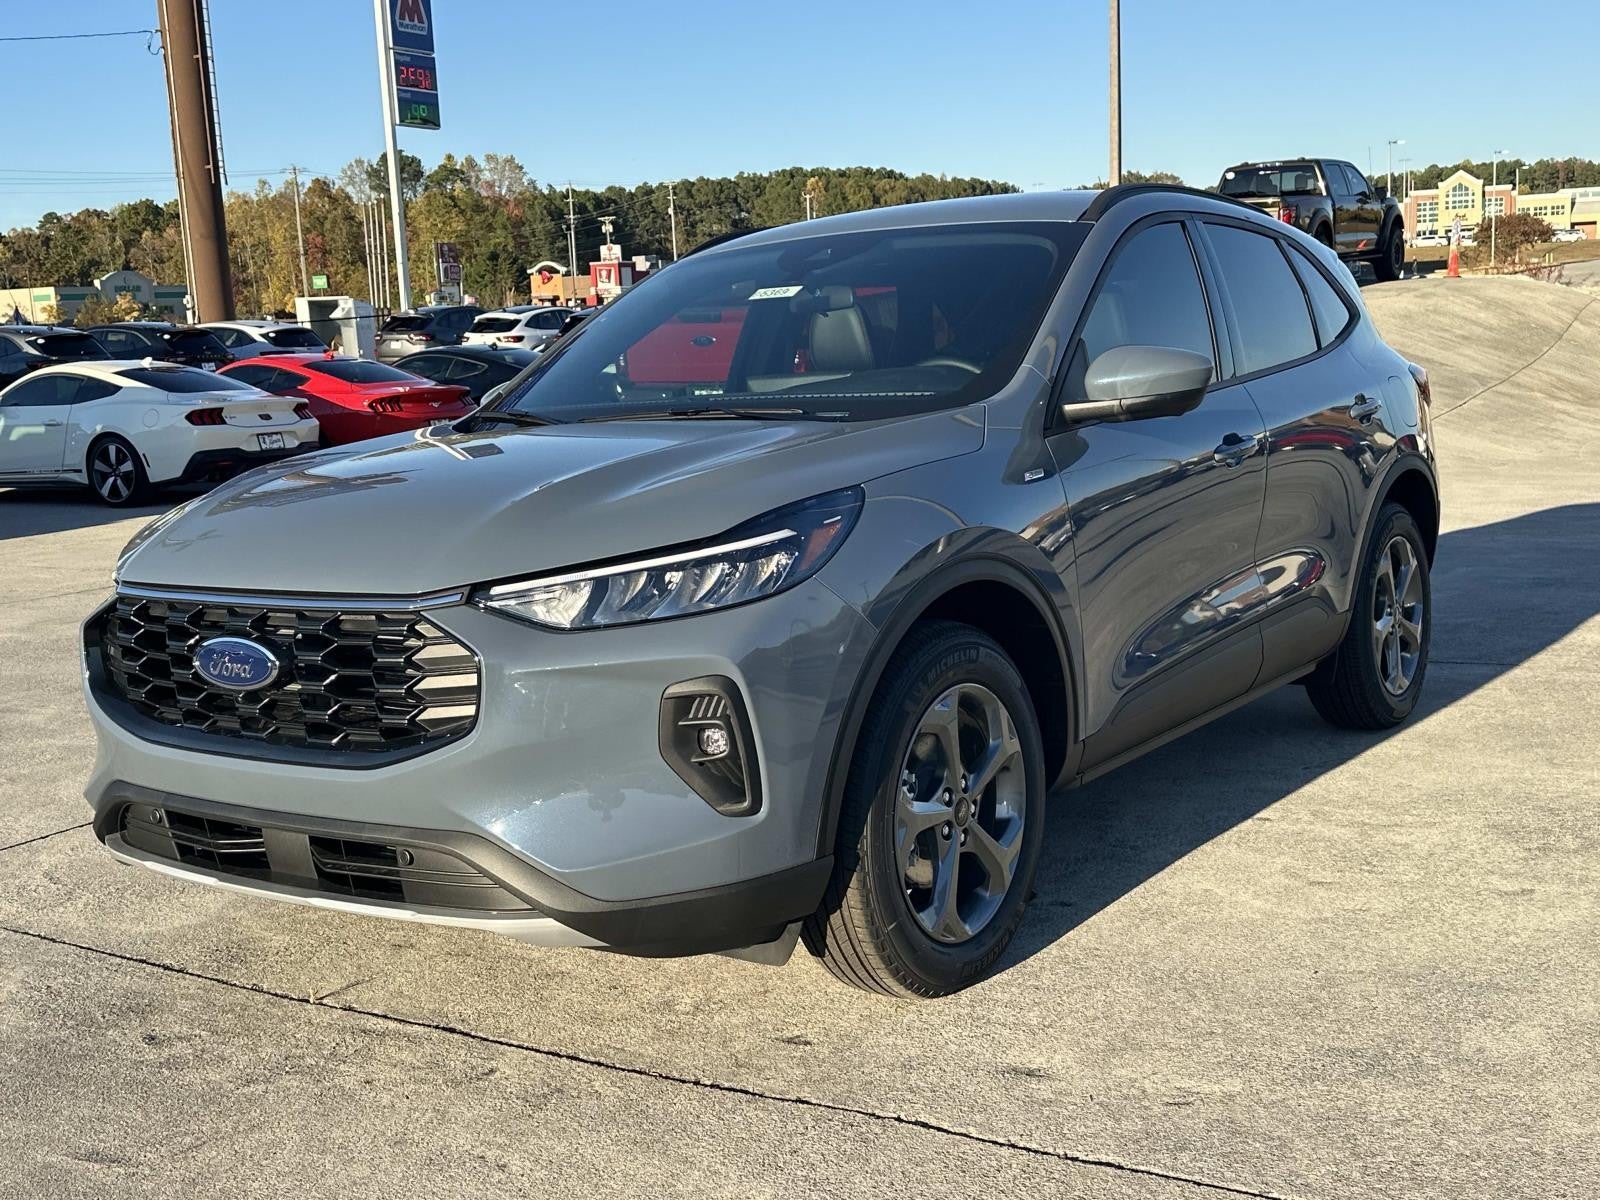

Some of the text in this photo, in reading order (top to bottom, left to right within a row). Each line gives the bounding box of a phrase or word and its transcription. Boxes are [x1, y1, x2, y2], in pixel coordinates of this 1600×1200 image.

[398, 21, 426, 33] Marathon
[209, 649, 254, 678] Ford
[927, 648, 978, 682] MICHELIN
